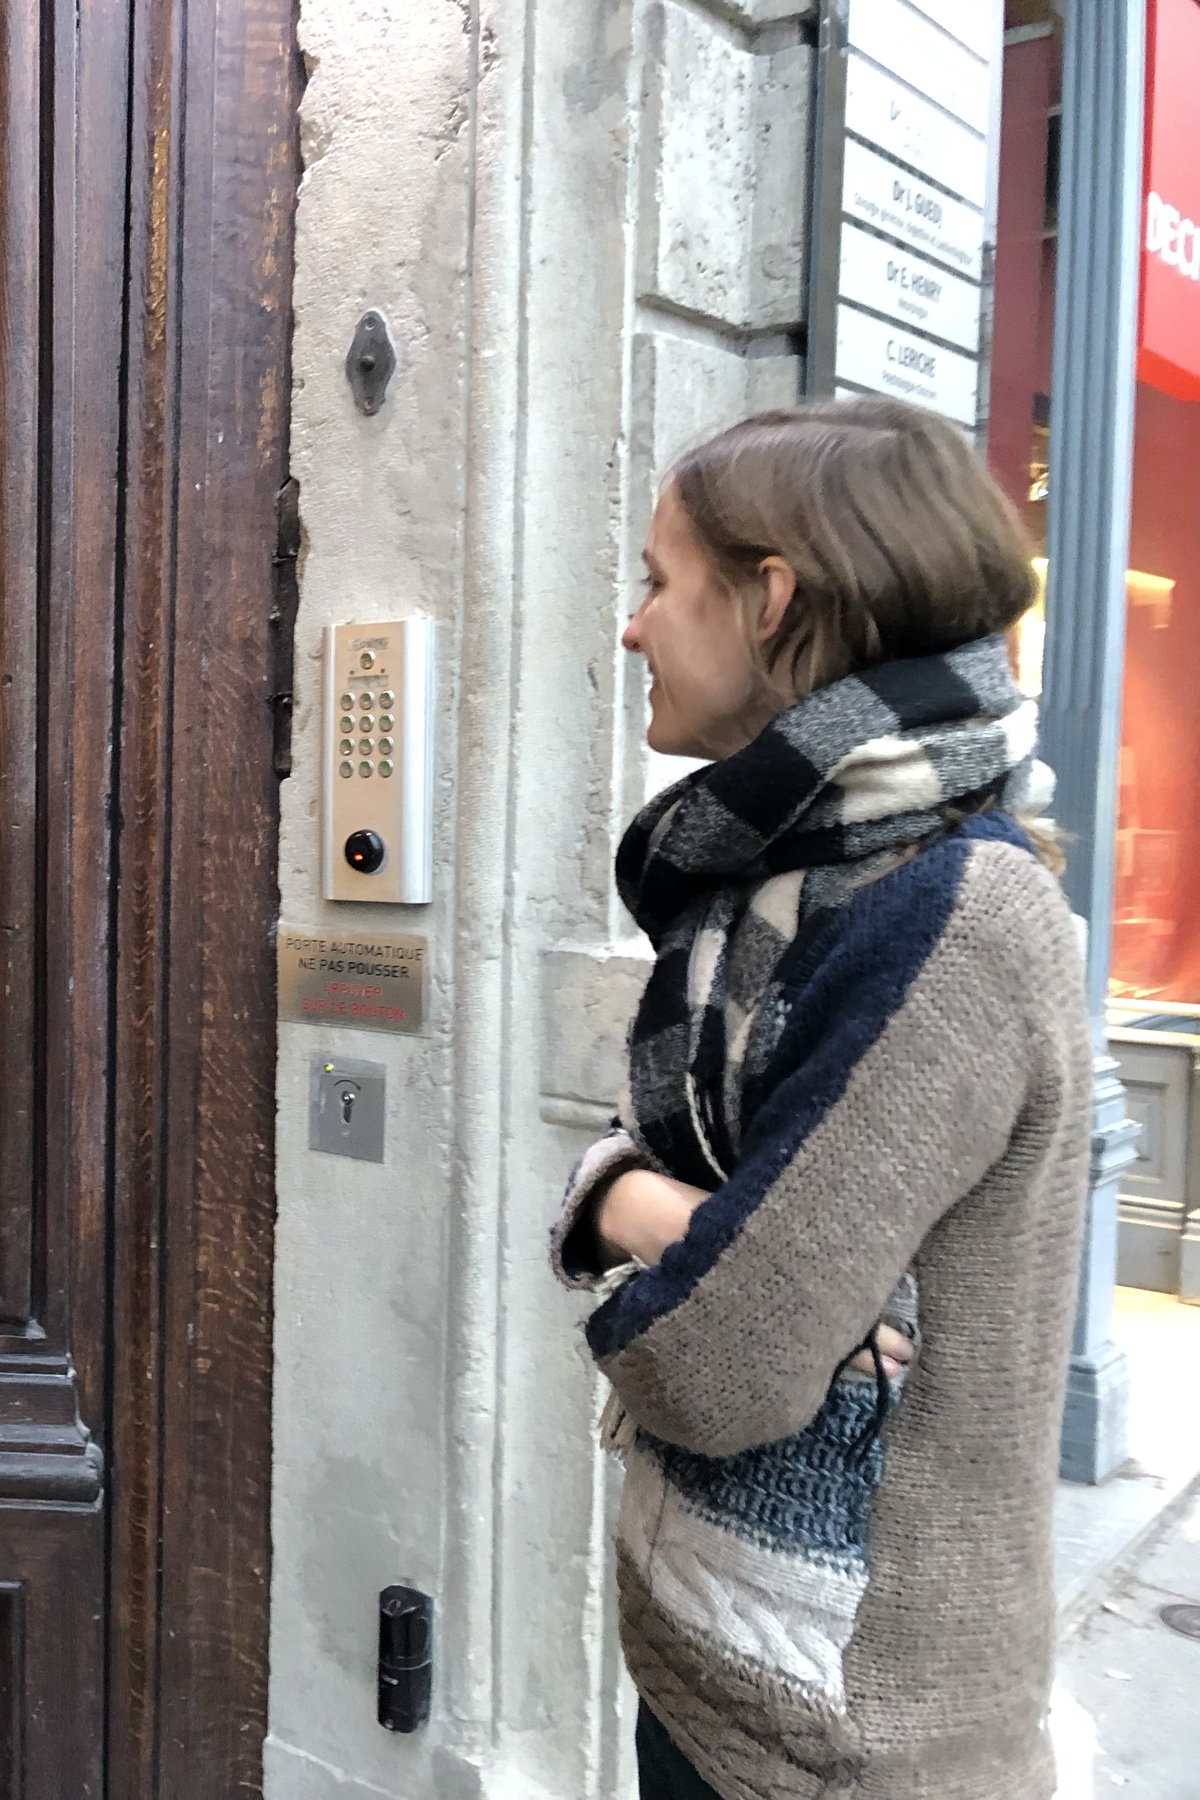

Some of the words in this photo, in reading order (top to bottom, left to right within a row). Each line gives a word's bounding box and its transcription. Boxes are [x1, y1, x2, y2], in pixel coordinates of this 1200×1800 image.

[893, 180, 905, 204] Dr
[887, 260, 899, 284] Dr
[286, 937, 327, 953] PORTE
[330, 941, 424, 961] AUTOMATIQUE
[298, 957, 316, 970] NE
[319, 959, 344, 973] PAS
[347, 961, 410, 979] POUSSER
[323, 981, 383, 999] APPUYER
[301, 997, 326, 1011] SUR
[330, 1000, 346, 1015] LE
[350, 1003, 405, 1020] BOUTON
